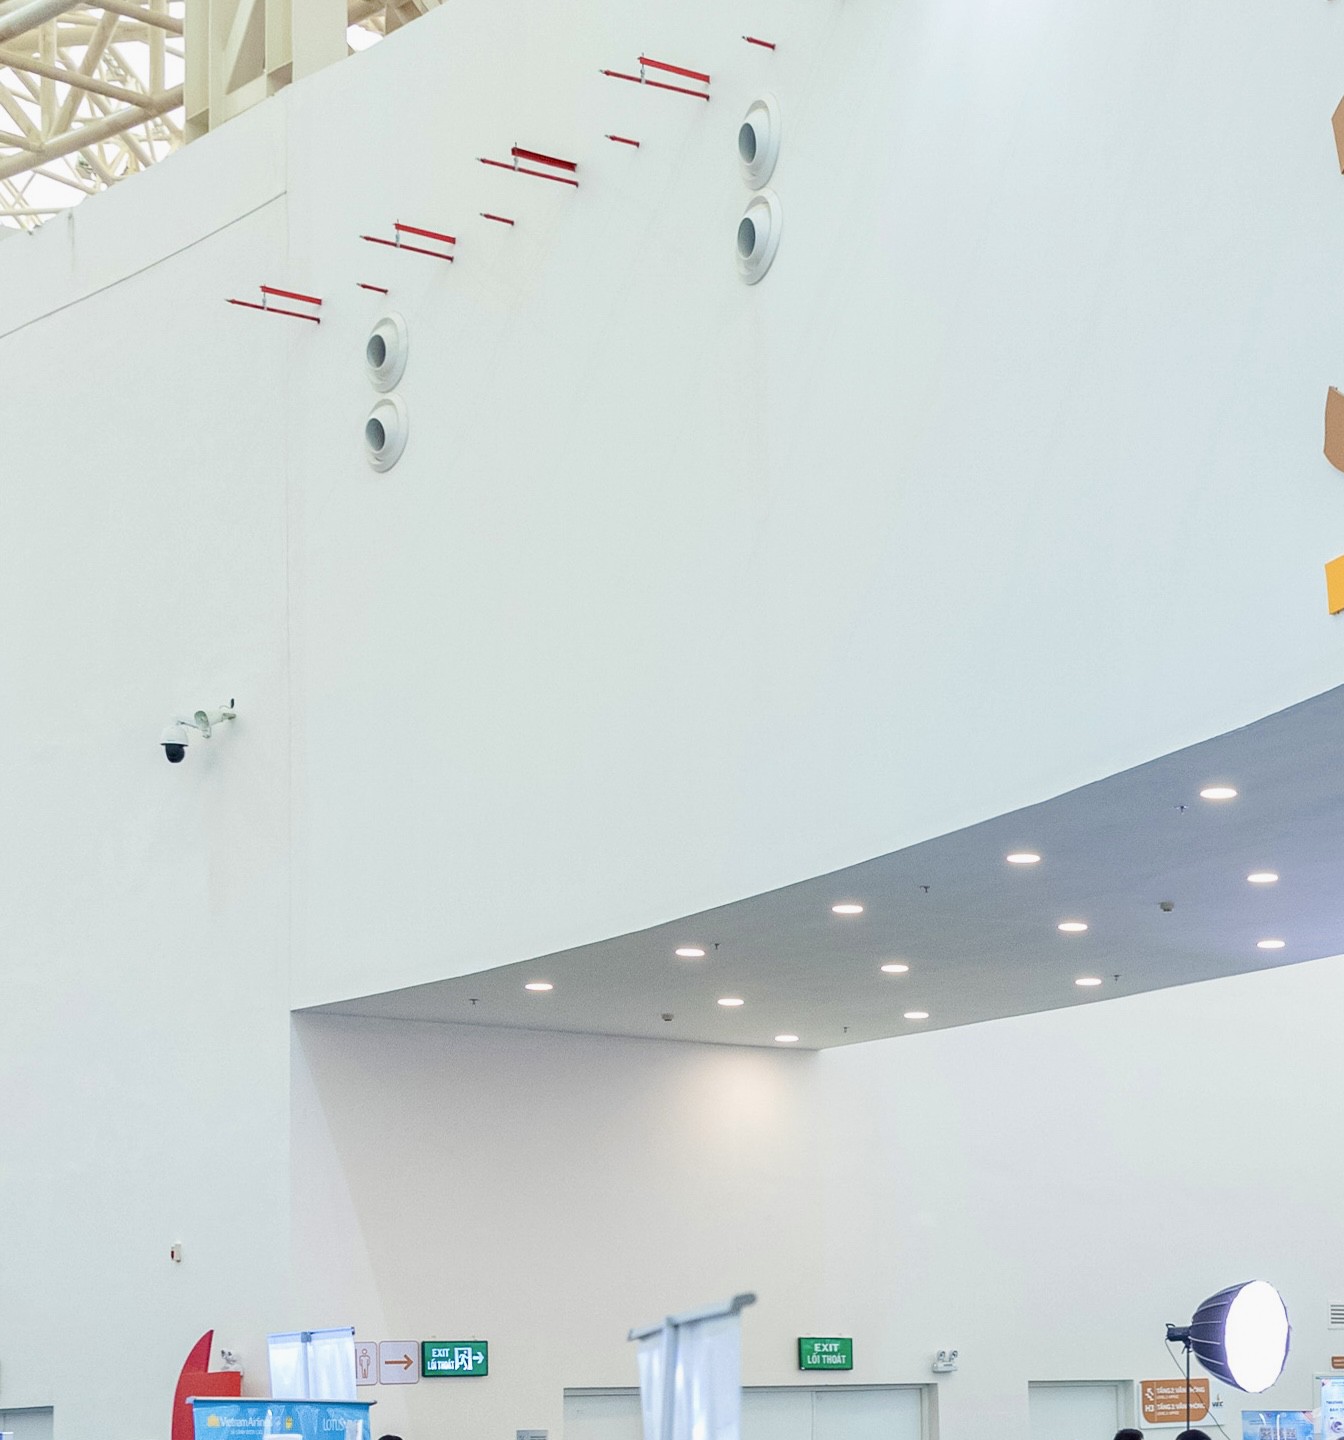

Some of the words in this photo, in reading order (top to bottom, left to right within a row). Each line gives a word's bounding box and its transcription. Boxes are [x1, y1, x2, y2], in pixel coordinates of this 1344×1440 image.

[814, 1343, 839, 1352] EXIT
[432, 1348, 450, 1357] EXIT
[807, 1351, 820, 1364] LỐI
[822, 1353, 846, 1364] THOÁT
